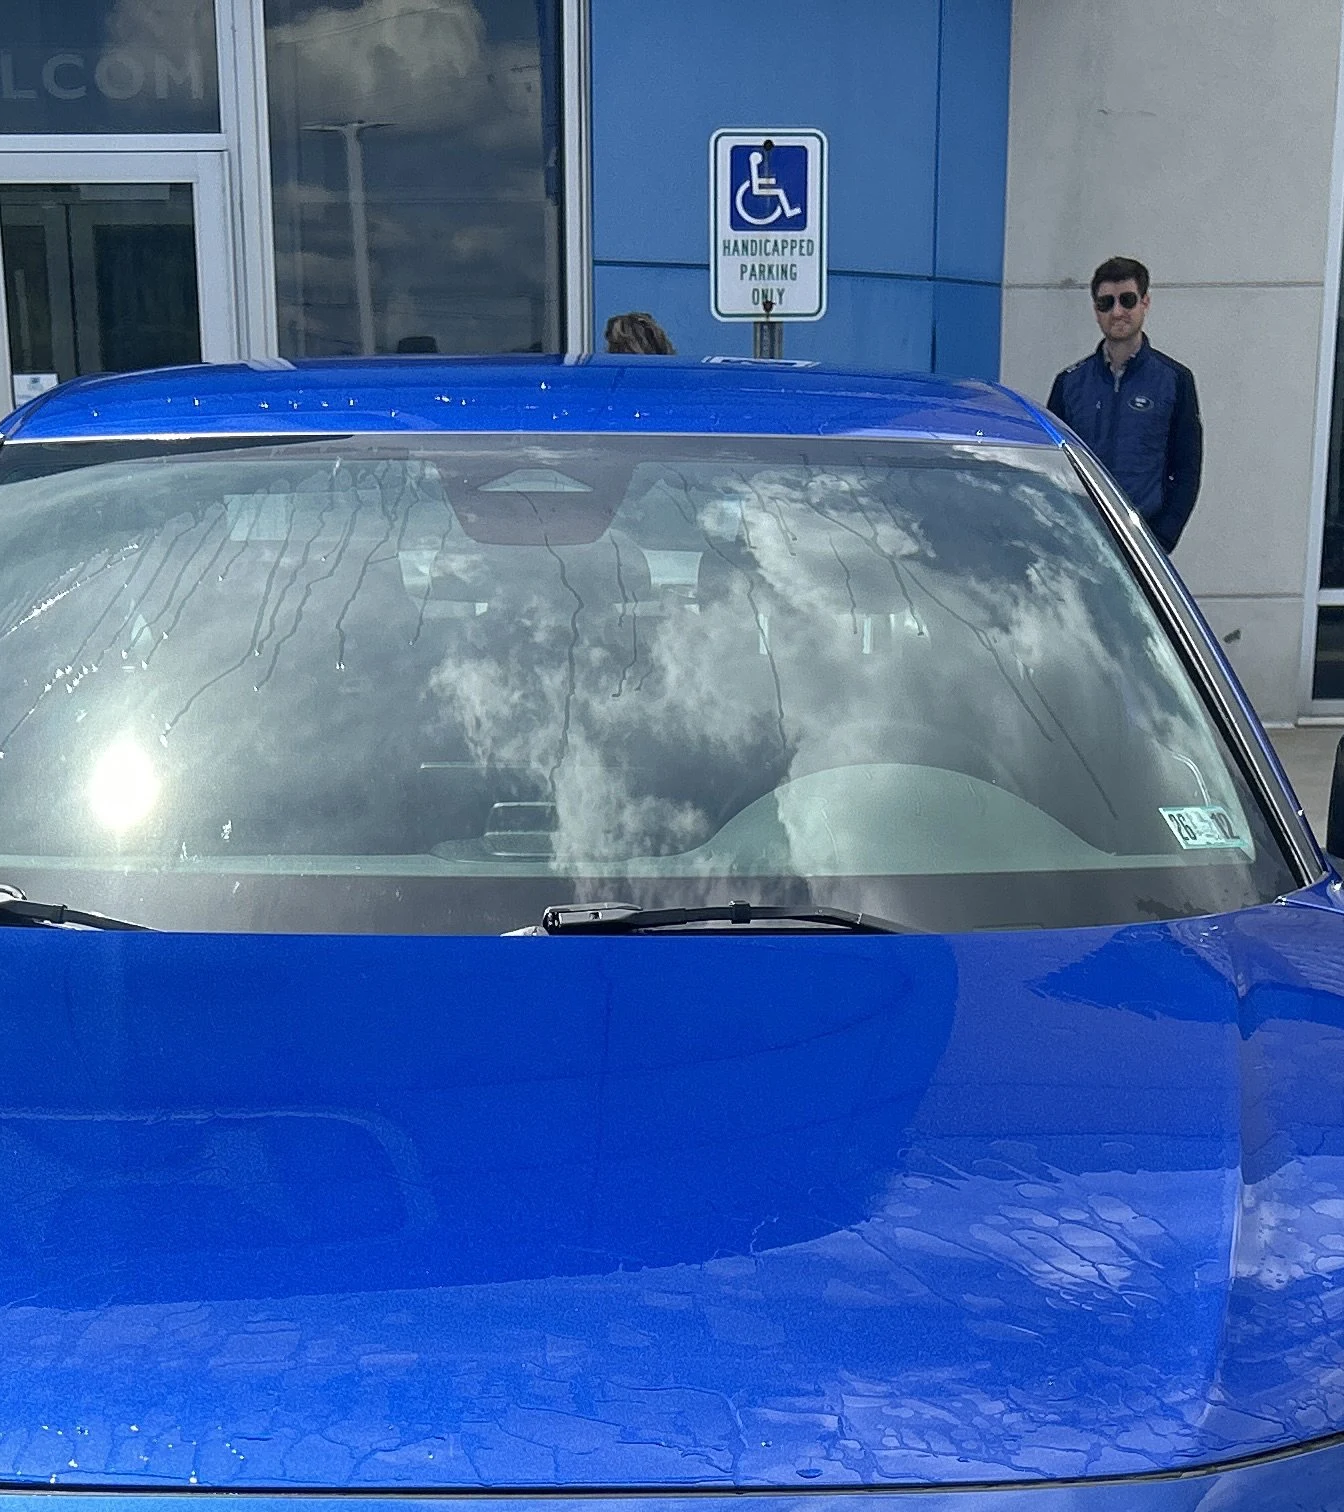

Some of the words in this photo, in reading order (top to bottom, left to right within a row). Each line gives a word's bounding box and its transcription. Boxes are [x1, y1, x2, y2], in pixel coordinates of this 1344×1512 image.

[722, 239, 814, 257] HANDICAPPED
[739, 263, 798, 281] PARKING
[751, 288, 786, 306] ONLY
[1168, 813, 1197, 841] 26
